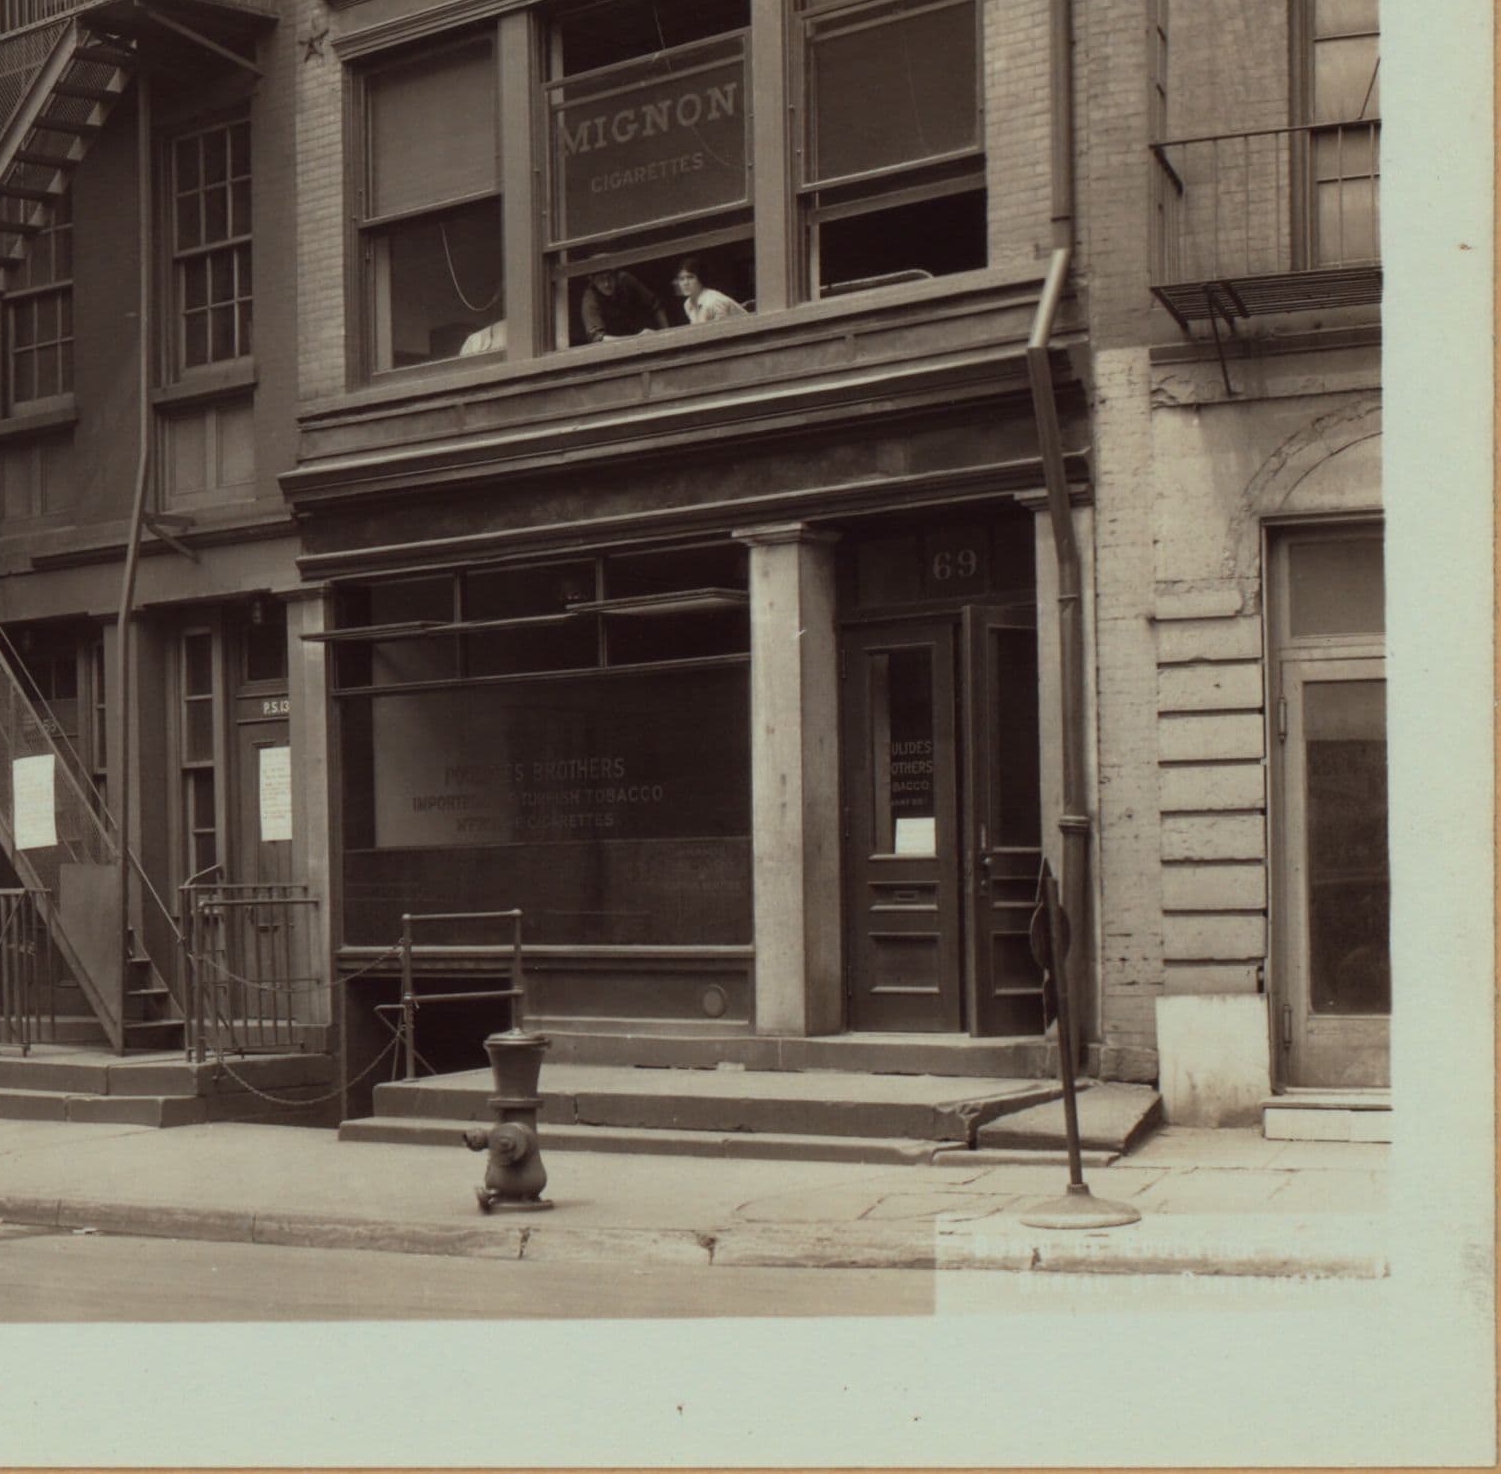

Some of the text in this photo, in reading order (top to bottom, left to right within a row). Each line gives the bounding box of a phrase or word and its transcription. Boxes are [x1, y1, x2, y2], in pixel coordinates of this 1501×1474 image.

[561, 83, 737, 156] MIGNON
[591, 153, 705, 193] CIGARETTES
[932, 549, 977, 580] 69
[532, 757, 626, 782] BROTHERS
[586, 783, 664, 805] TOBACCO
